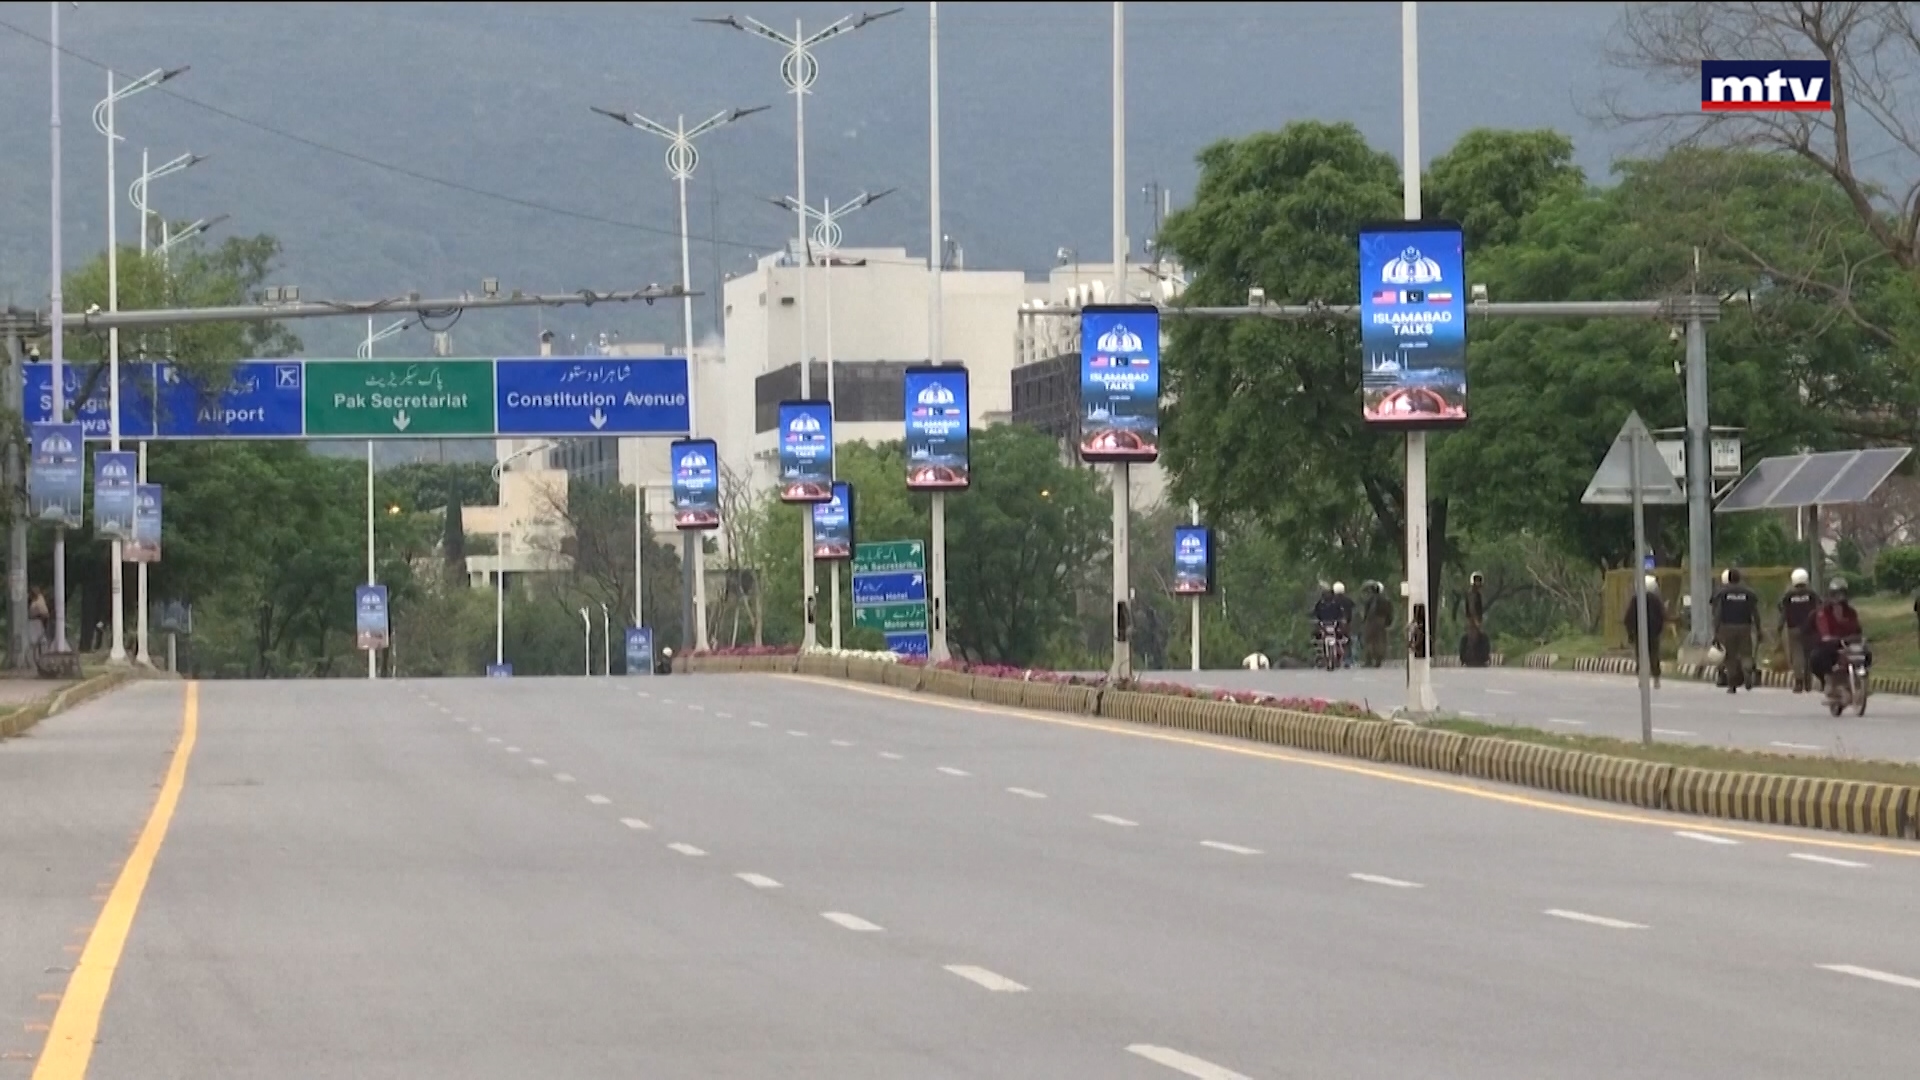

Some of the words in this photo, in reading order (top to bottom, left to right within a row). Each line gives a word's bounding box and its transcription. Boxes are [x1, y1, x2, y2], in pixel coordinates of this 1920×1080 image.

[1373, 311, 1453, 324] ISLAMABAD
[1392, 323, 1434, 336] TALKS
[335, 393, 367, 409] Pak
[371, 392, 468, 409] Secretariat
[507, 391, 616, 408] Constitution
[623, 390, 686, 407] Avenue
[196, 406, 265, 426] Airport
